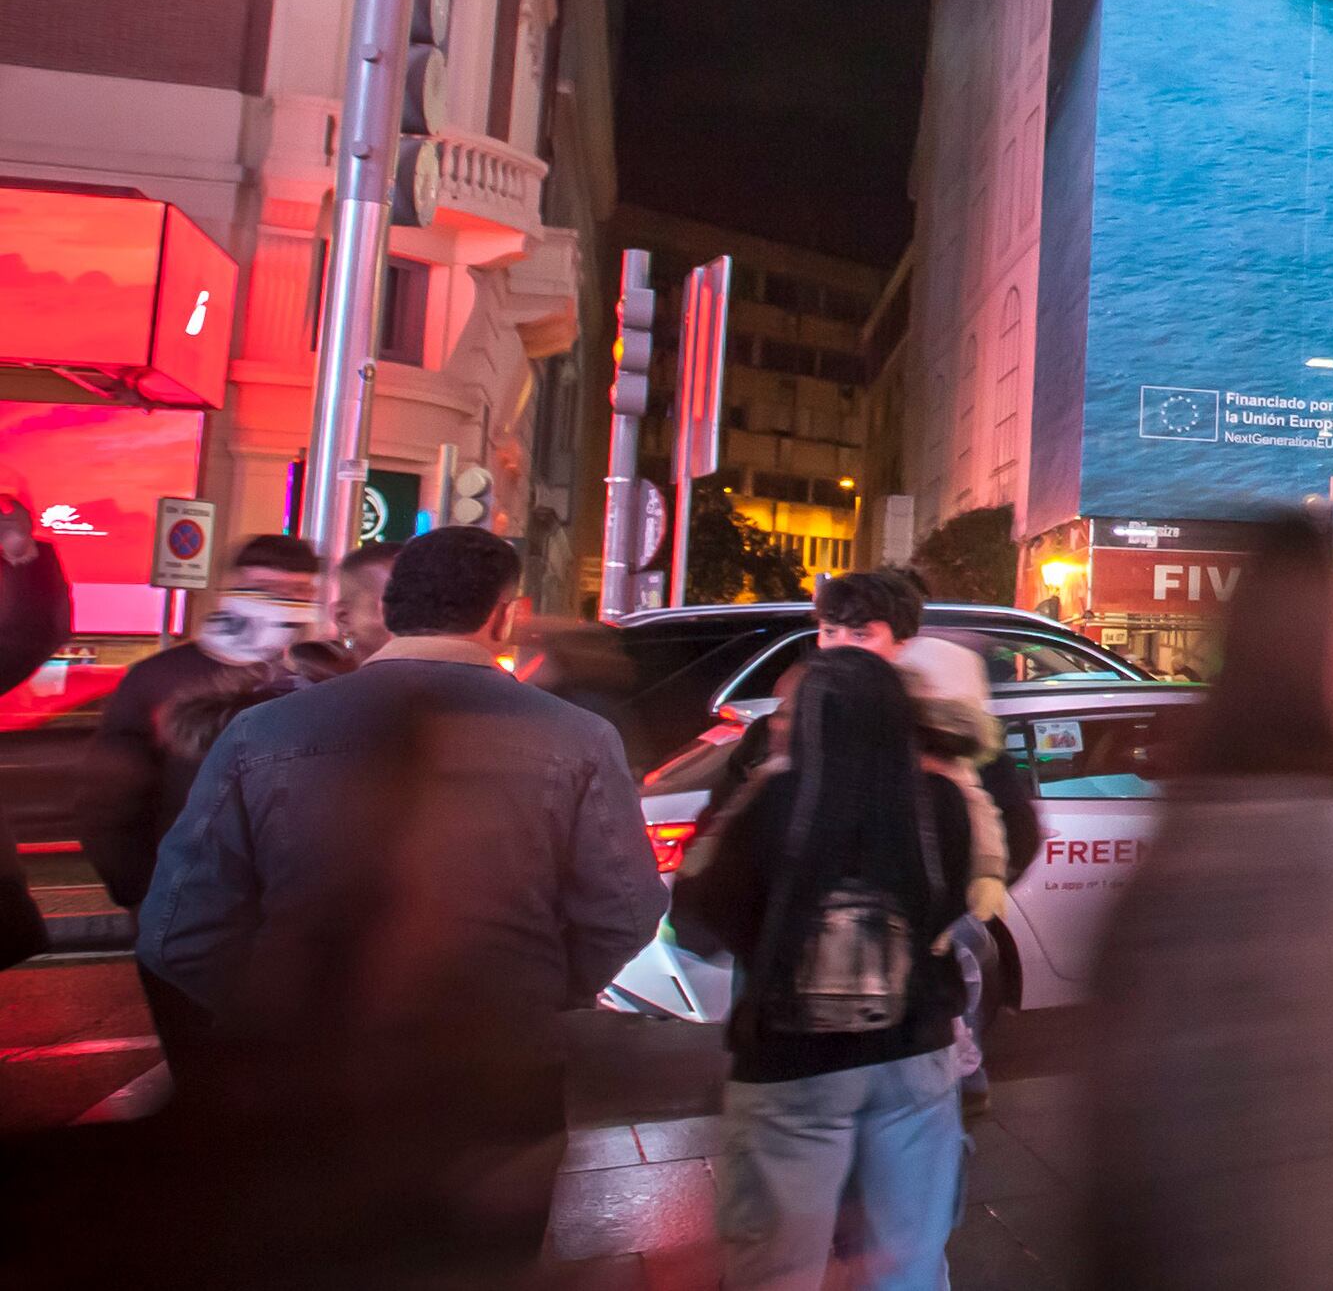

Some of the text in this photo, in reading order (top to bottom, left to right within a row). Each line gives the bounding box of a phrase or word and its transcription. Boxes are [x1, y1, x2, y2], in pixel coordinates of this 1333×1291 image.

[1226, 392, 1333, 414] Financiado por
[1225, 411, 1239, 424] la
[1241, 412, 1286, 427] Unión
[1153, 564, 1243, 603] FIV
